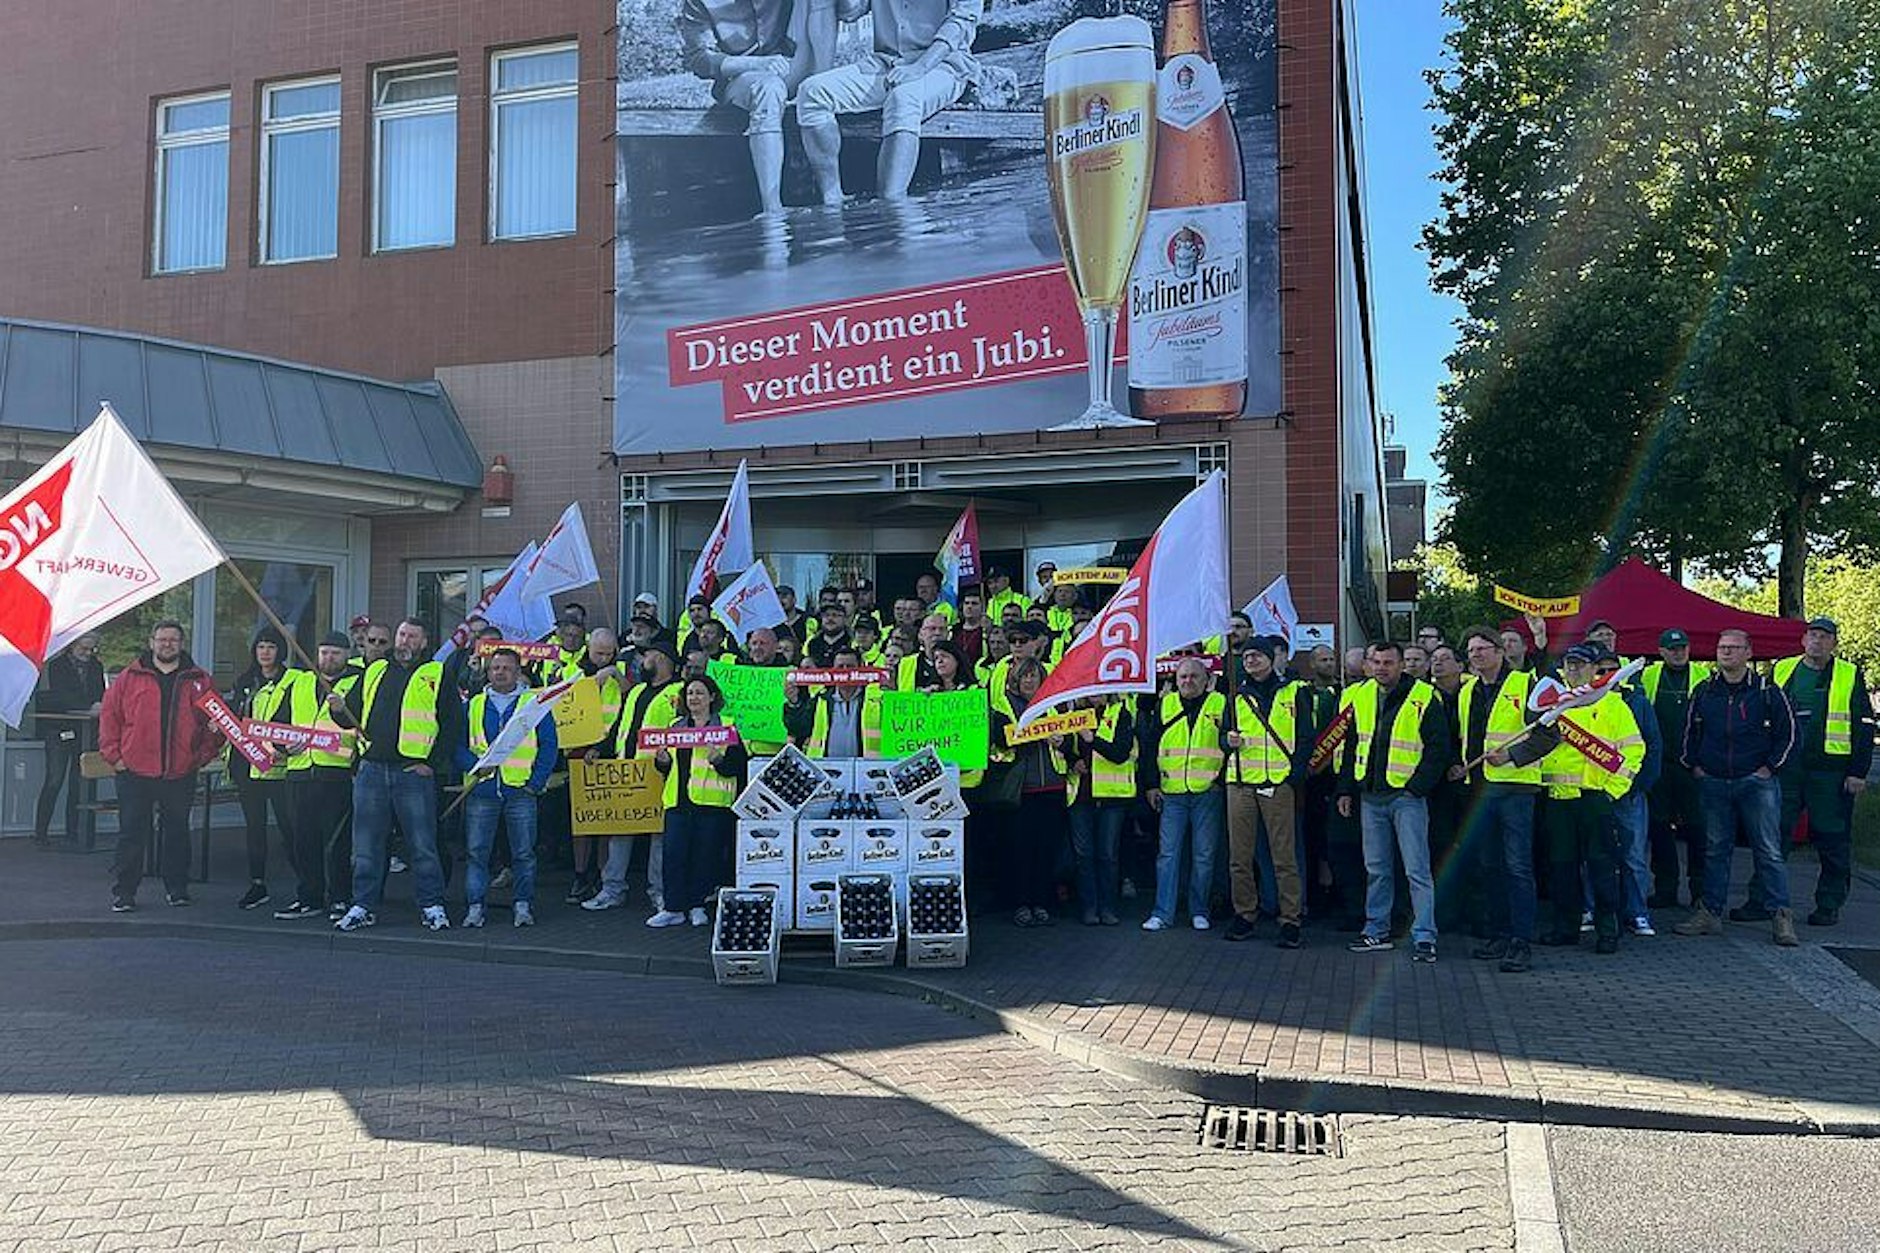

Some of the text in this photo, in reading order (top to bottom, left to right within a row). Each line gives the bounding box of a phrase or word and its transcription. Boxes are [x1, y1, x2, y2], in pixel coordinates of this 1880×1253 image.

[1057, 112, 1140, 155] Berliner Kindl
[1133, 279, 1198, 317] Berliner
[685, 299, 968, 373] Dieser Moment
[743, 325, 1066, 404] verdient ein Jubi.
[1102, 571, 1120, 579] AUF
[1547, 602, 1571, 613] AUF
[205, 698, 223, 719] ICH
[243, 739, 267, 762] AUF
[891, 716, 926, 733] WIR
[1068, 716, 1087, 727] AUF
[248, 723, 334, 746] ICH STEH' AUF
[644, 731, 729, 745] ICH STEH' AUF
[1587, 743, 1613, 763] AUF
[584, 762, 647, 787] LEBEN
[575, 805, 663, 823] ÜBERLEBEN
